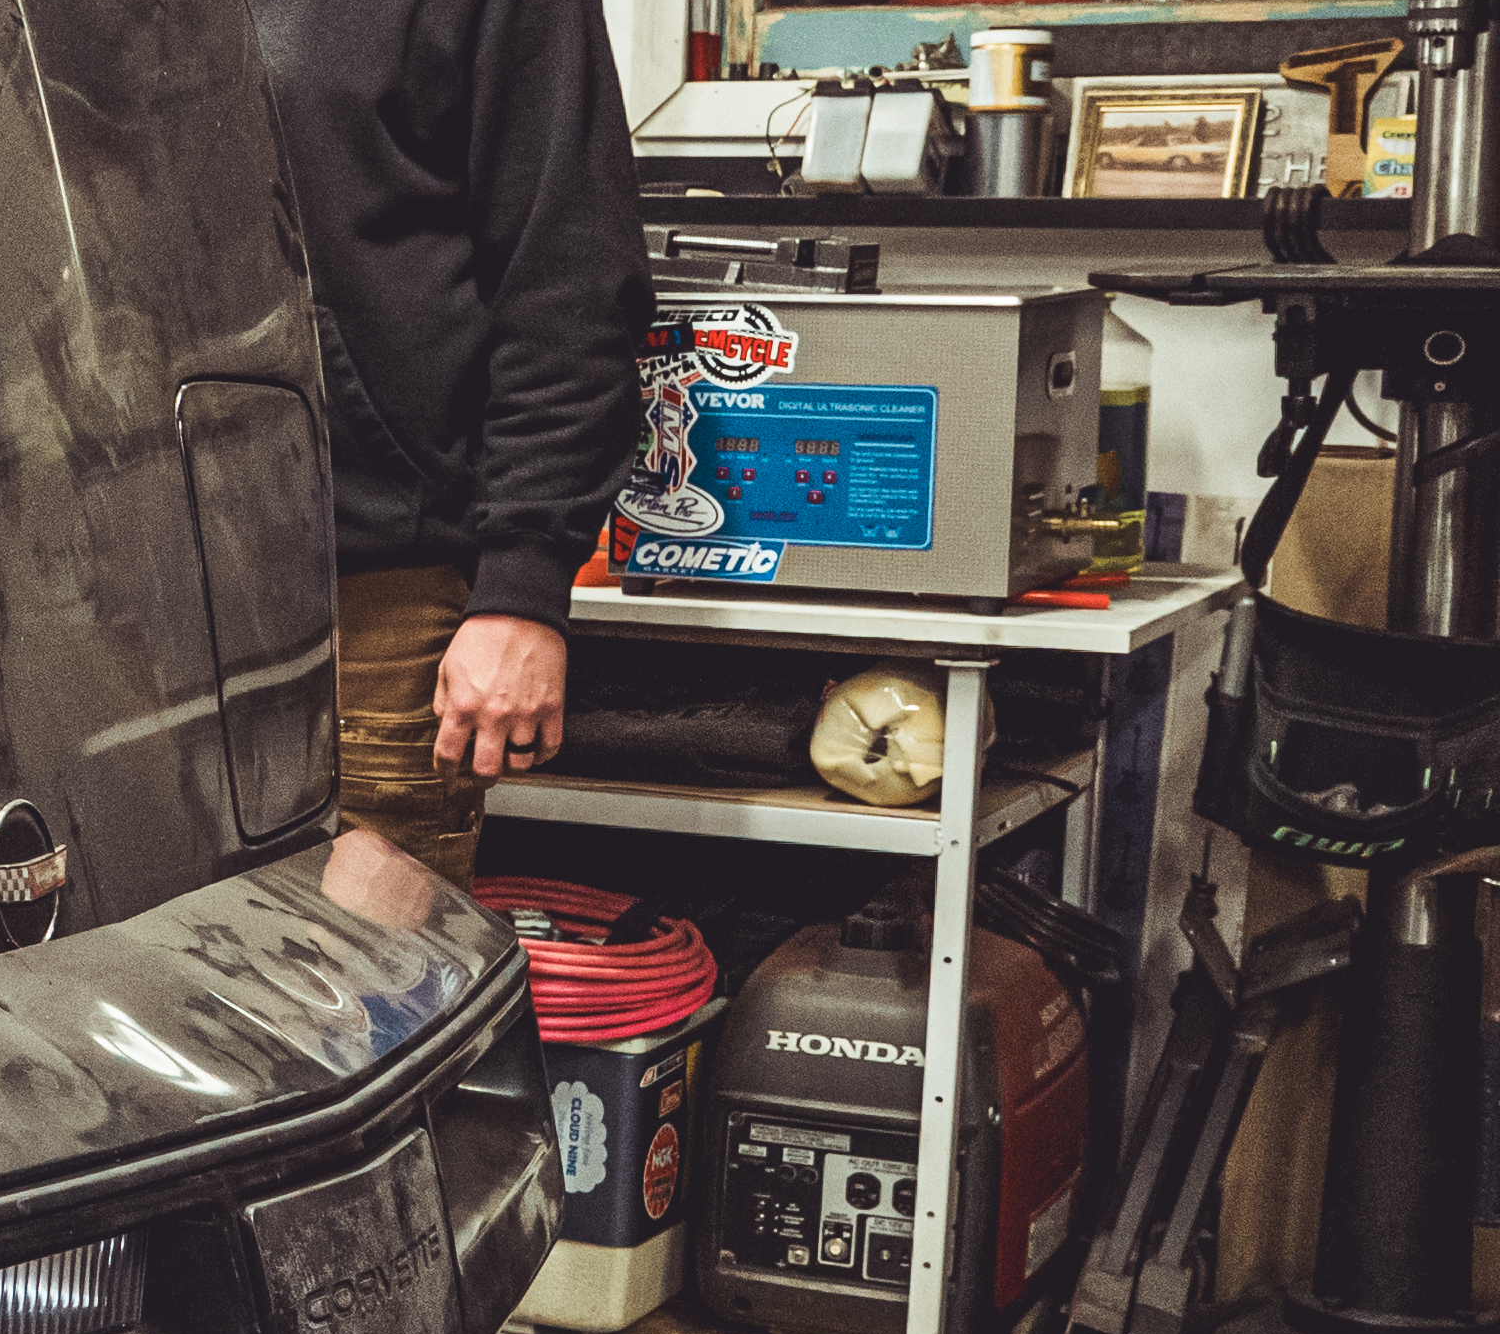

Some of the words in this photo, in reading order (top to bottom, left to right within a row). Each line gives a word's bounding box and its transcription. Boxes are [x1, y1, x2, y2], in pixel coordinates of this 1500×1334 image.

[1373, 158, 1414, 178] Cha
[695, 392, 765, 409] VEVOR
[778, 400, 814, 411] DIGITAL
[817, 402, 877, 413] ULTRASONIC
[880, 405, 926, 415] CLEANER
[674, 497, 704, 518] Pro
[635, 540, 778, 575] COMETIC
[765, 1029, 927, 1068] HONDA
[569, 1097, 582, 1142] CLOUD
[566, 1144, 579, 1177] NINE
[652, 1145, 673, 1169] NGK
[304, 1222, 441, 1325] CORVETTE
